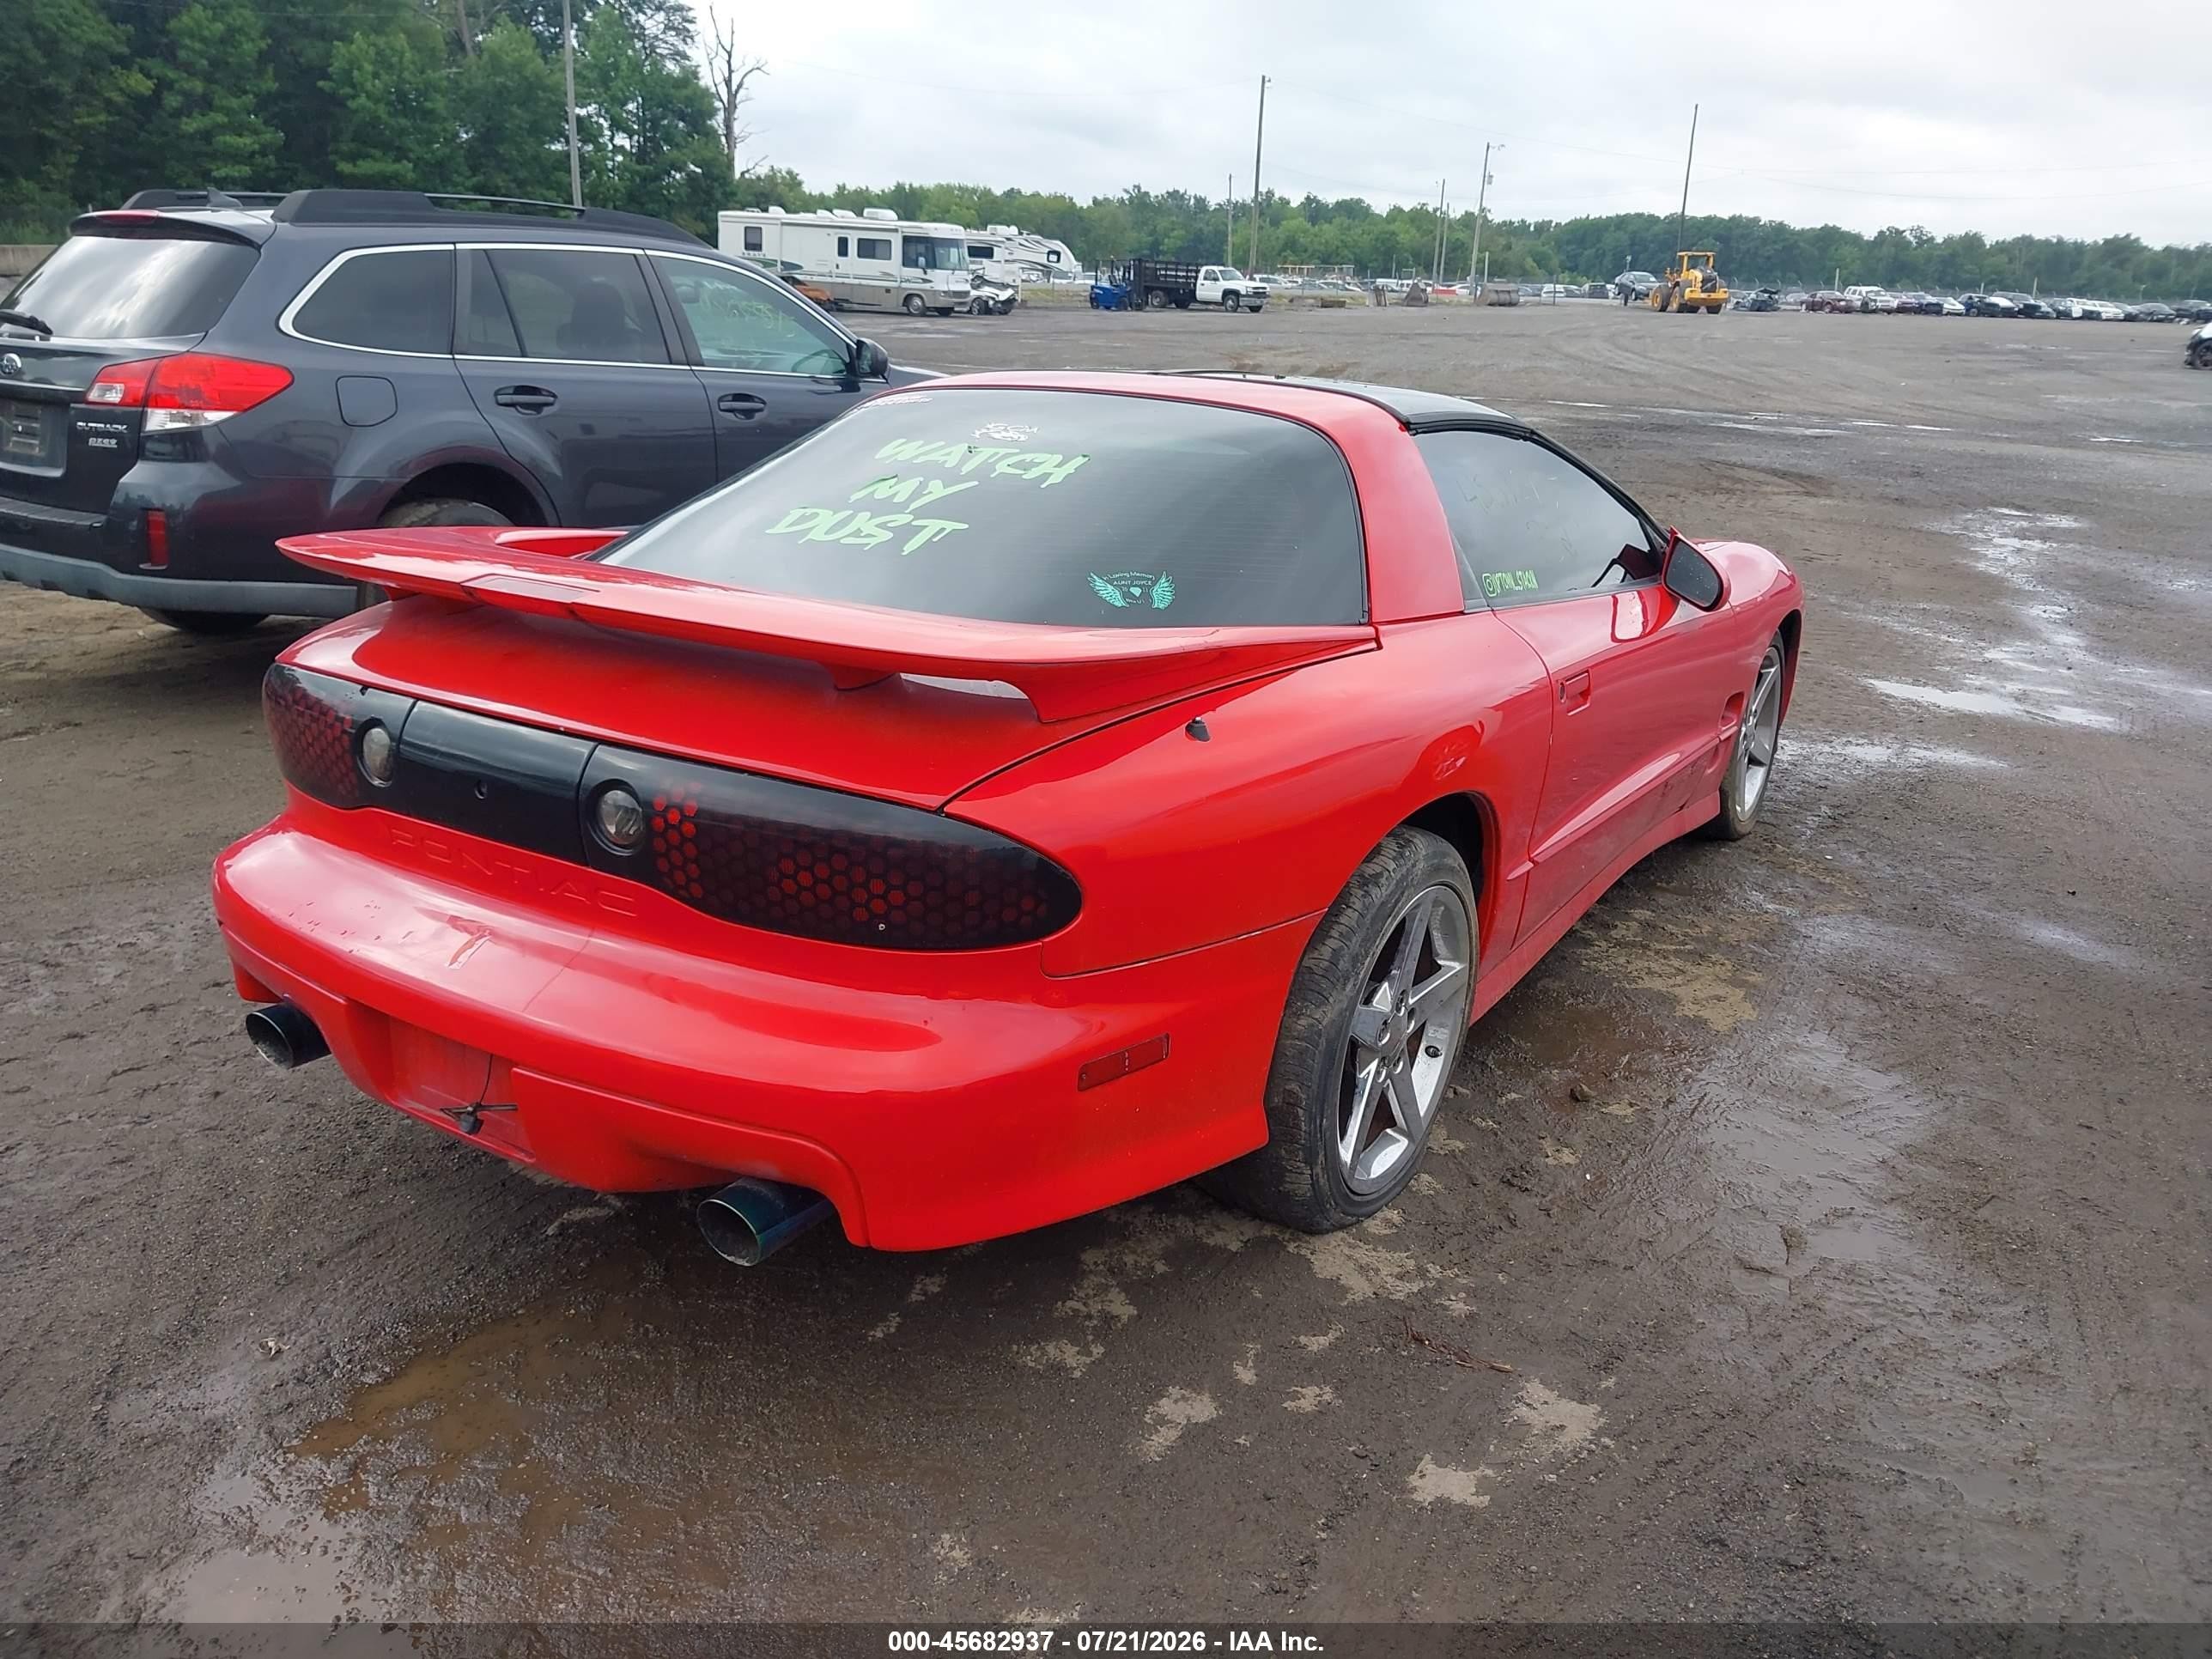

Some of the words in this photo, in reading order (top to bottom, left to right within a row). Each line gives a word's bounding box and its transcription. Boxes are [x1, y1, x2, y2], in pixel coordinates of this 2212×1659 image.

[874, 438, 1091, 489] WATCH
[848, 474, 979, 513] MY
[765, 507, 969, 556] DUST
[390, 828, 639, 917] PONTIAC
